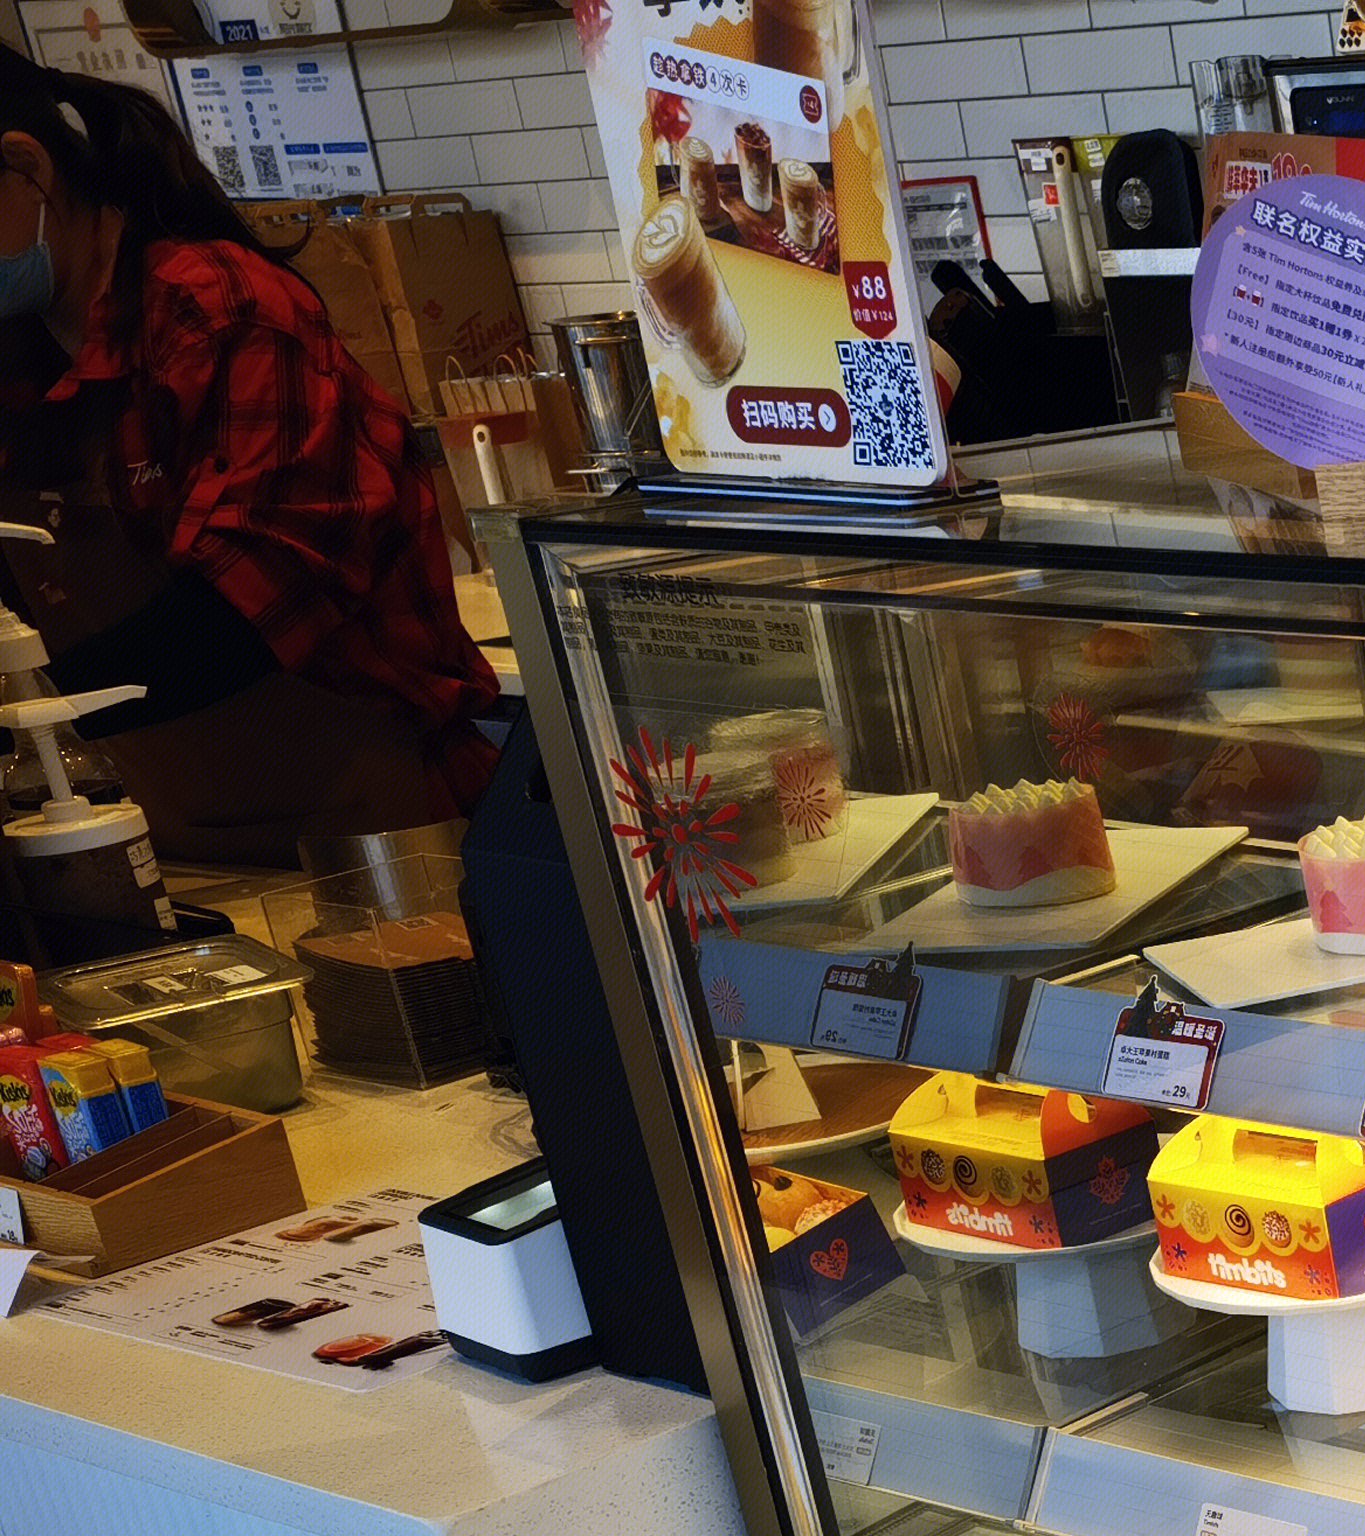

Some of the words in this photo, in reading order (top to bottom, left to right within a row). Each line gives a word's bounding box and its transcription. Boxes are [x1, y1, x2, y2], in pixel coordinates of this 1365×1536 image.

[1301, 191, 1321, 213] Tim
[1268, 252, 1286, 267] Tim
[1287, 257, 1324, 282] Hortons
[740, 399, 817, 431] 扫码购买
[1207, 1252, 1287, 1289] timbits
